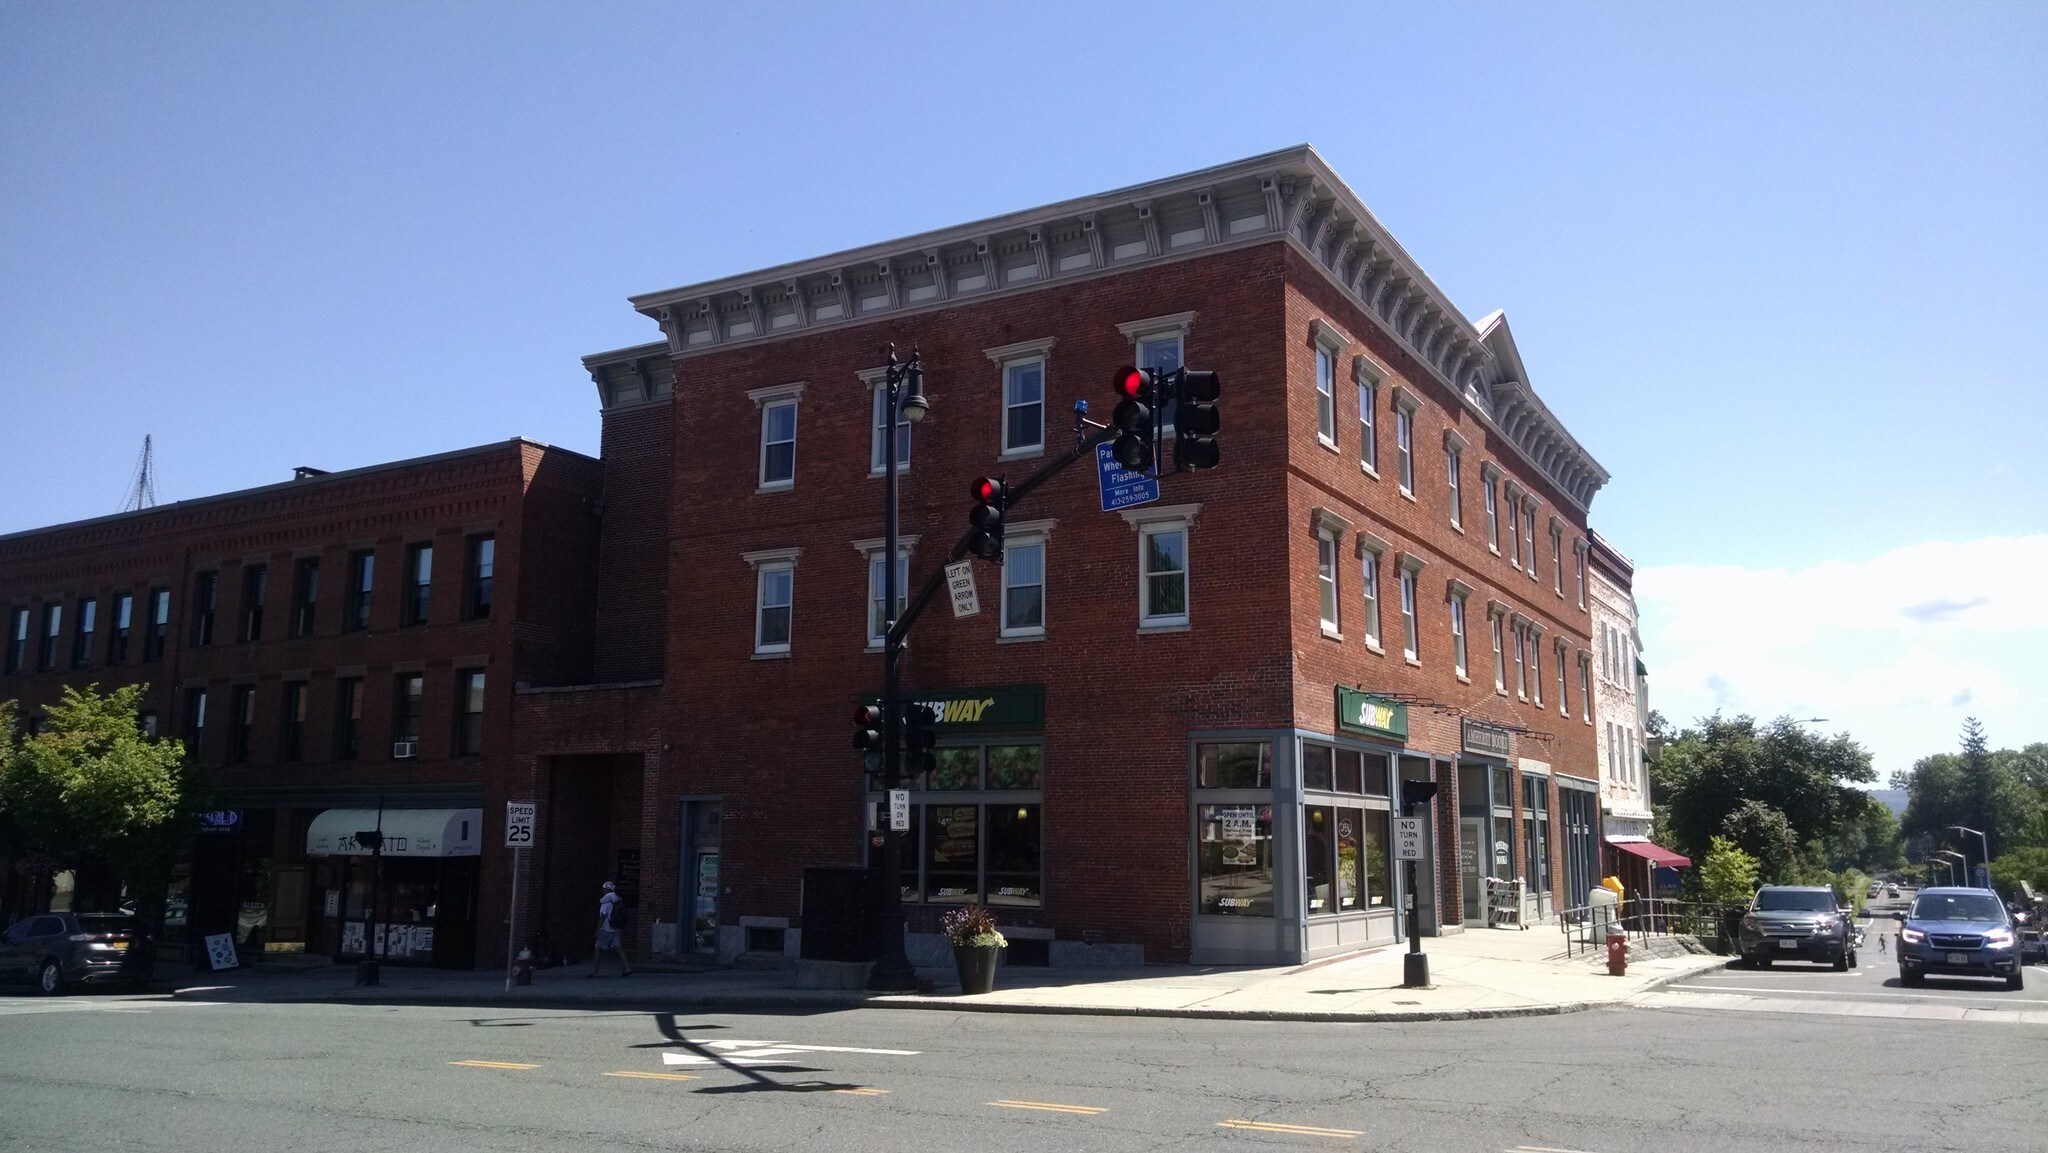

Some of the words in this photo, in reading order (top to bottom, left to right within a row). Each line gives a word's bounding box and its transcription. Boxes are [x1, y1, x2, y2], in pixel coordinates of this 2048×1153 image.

[1114, 488, 1129, 497] More
[1132, 485, 1144, 493] Info
[1111, 491, 1150, 506] 413-259-3005
[946, 567, 961, 579] LEFT
[961, 566, 971, 575] ON
[952, 578, 971, 590] GREEN
[954, 590, 974, 601] ARROW
[957, 602, 973, 613] ONLY
[903, 697, 995, 724] BWAY
[1358, 702, 1394, 730] SUBWAY
[1467, 728, 1491, 747] AMHERST
[895, 793, 905, 801] NO
[510, 807, 534, 815] SPEED
[511, 816, 531, 824] LIMIT
[1225, 819, 1231, 827] 2
[1233, 819, 1252, 828] A.M.
[1401, 821, 1416, 830] NO
[509, 825, 531, 842] 25
[1399, 831, 1418, 839] TURN
[1403, 840, 1415, 848] ON
[938, 887, 968, 897] SUBWAY
[998, 886, 1029, 897] SUBWAY
[1218, 897, 1254, 908] SUBWAY
